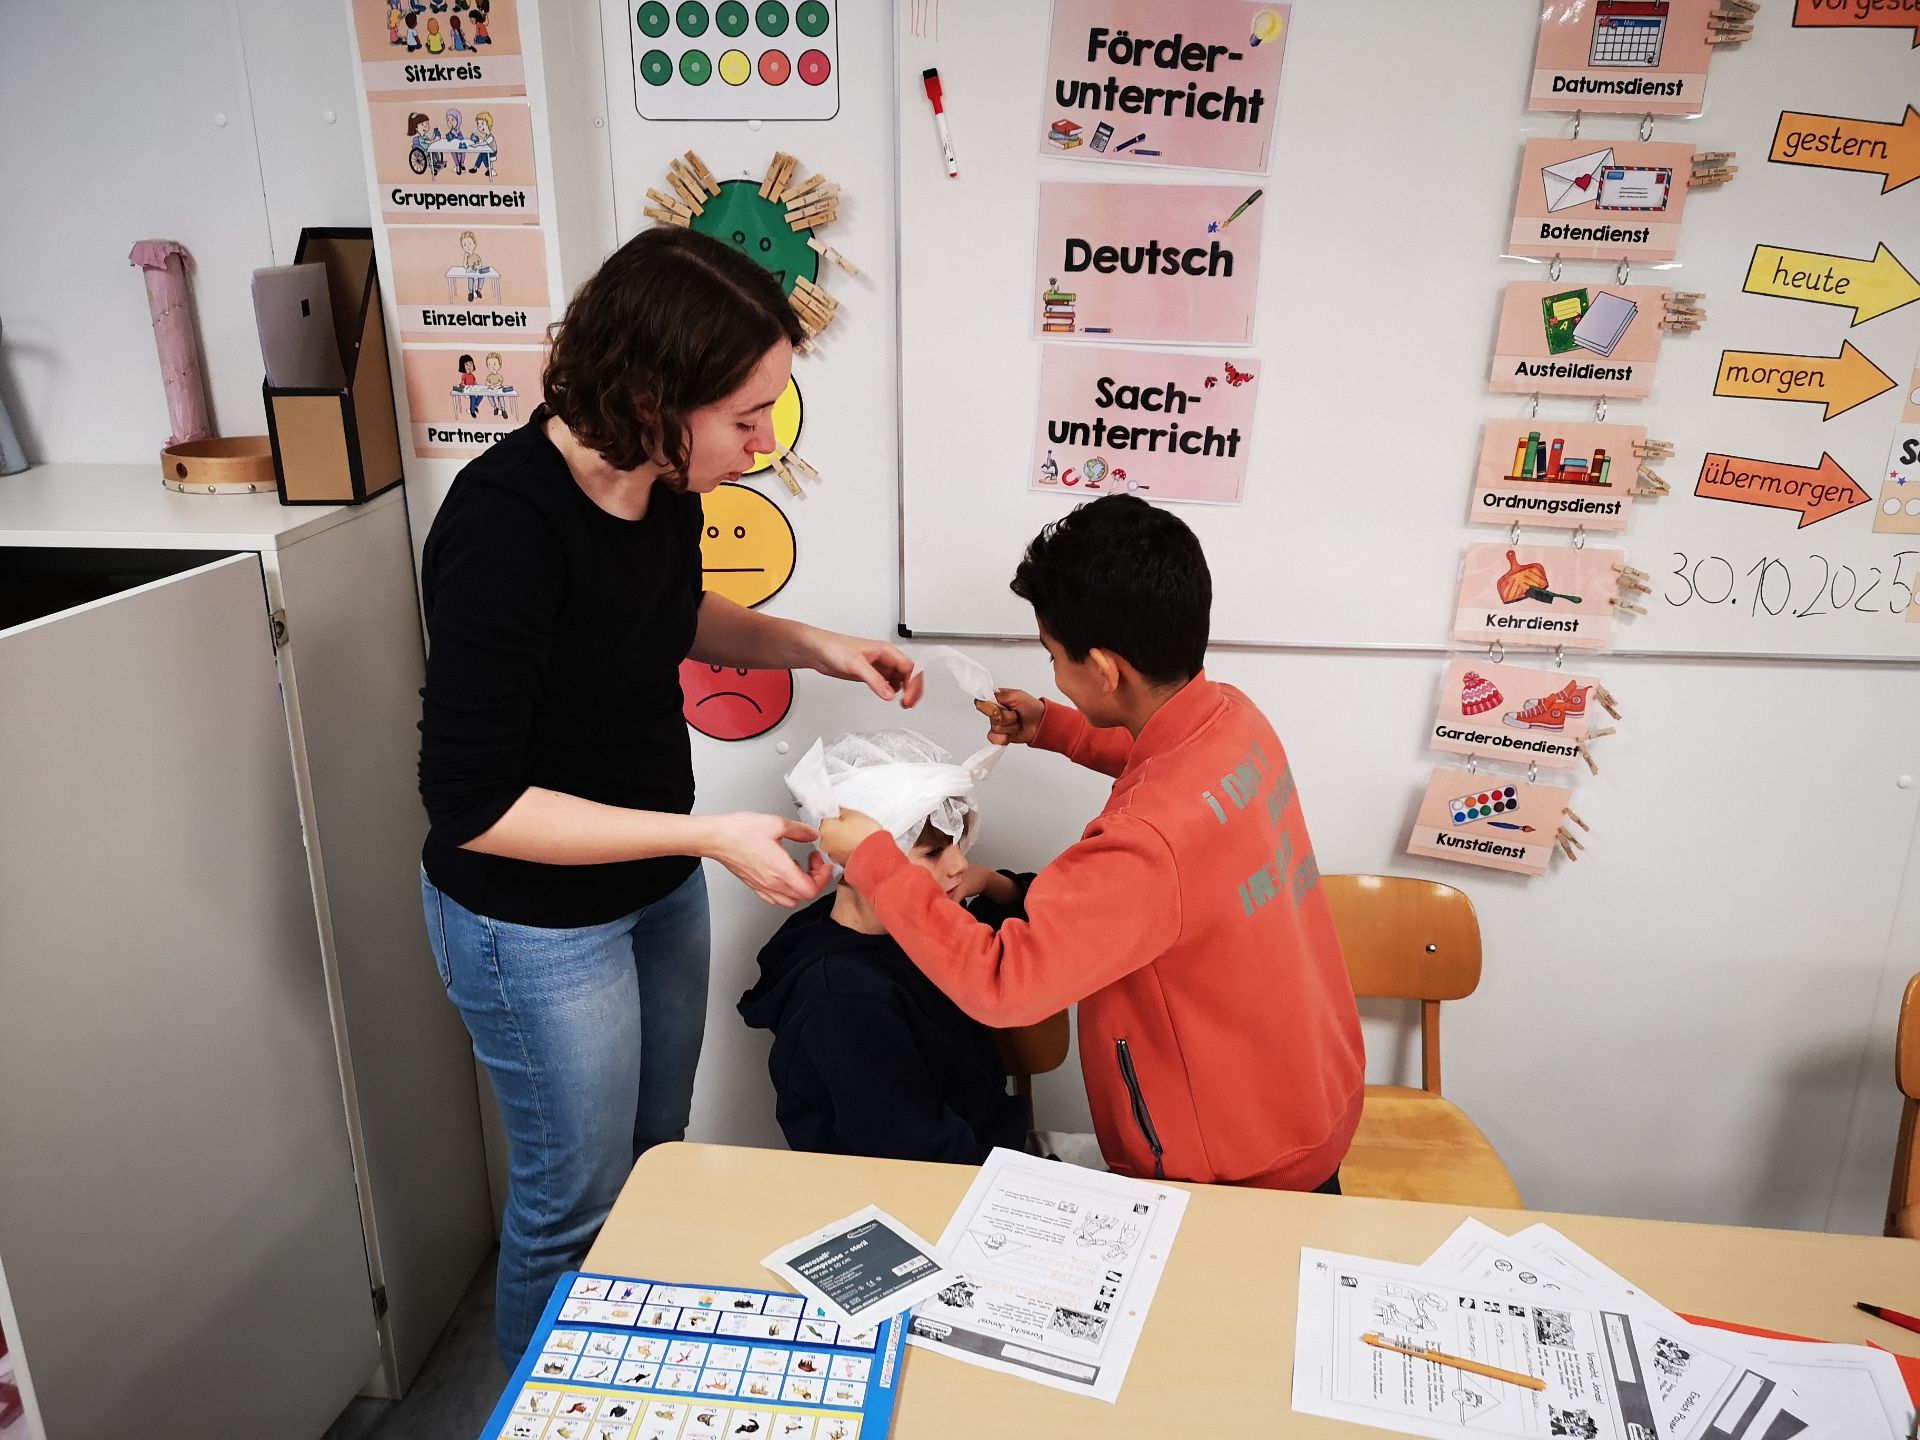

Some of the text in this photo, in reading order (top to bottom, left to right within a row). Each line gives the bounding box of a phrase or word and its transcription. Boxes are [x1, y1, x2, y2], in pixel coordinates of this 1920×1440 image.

[1088, 27, 1244, 73] Förder-
[405, 62, 482, 83] Sitzkreis
[1552, 76, 1683, 97] Datumsdienst
[1055, 77, 1264, 123] unterricht
[1783, 126, 1888, 159] gestern
[392, 189, 526, 211] Gruppenarbeit
[1540, 224, 1650, 244] Botendienst
[1065, 238, 1235, 278] Deutsch
[1772, 255, 1851, 295] heute
[423, 310, 527, 328] Einzelarbeit
[1515, 361, 1633, 381] Austeildienst
[1726, 364, 1826, 394] morgen
[1095, 376, 1202, 415] Sach-
[428, 428, 510, 443] Partnera
[1048, 417, 1241, 457] unterricht
[1704, 460, 1855, 507] übermorgen
[1483, 493, 1622, 516] Ordnungsdienst
[1664, 551, 1920, 618] 30.10.2025
[1486, 613, 1579, 633] Kehrdienst
[1435, 725, 1579, 758] Garderobendienst
[1436, 833, 1526, 860] Kunstdienst
